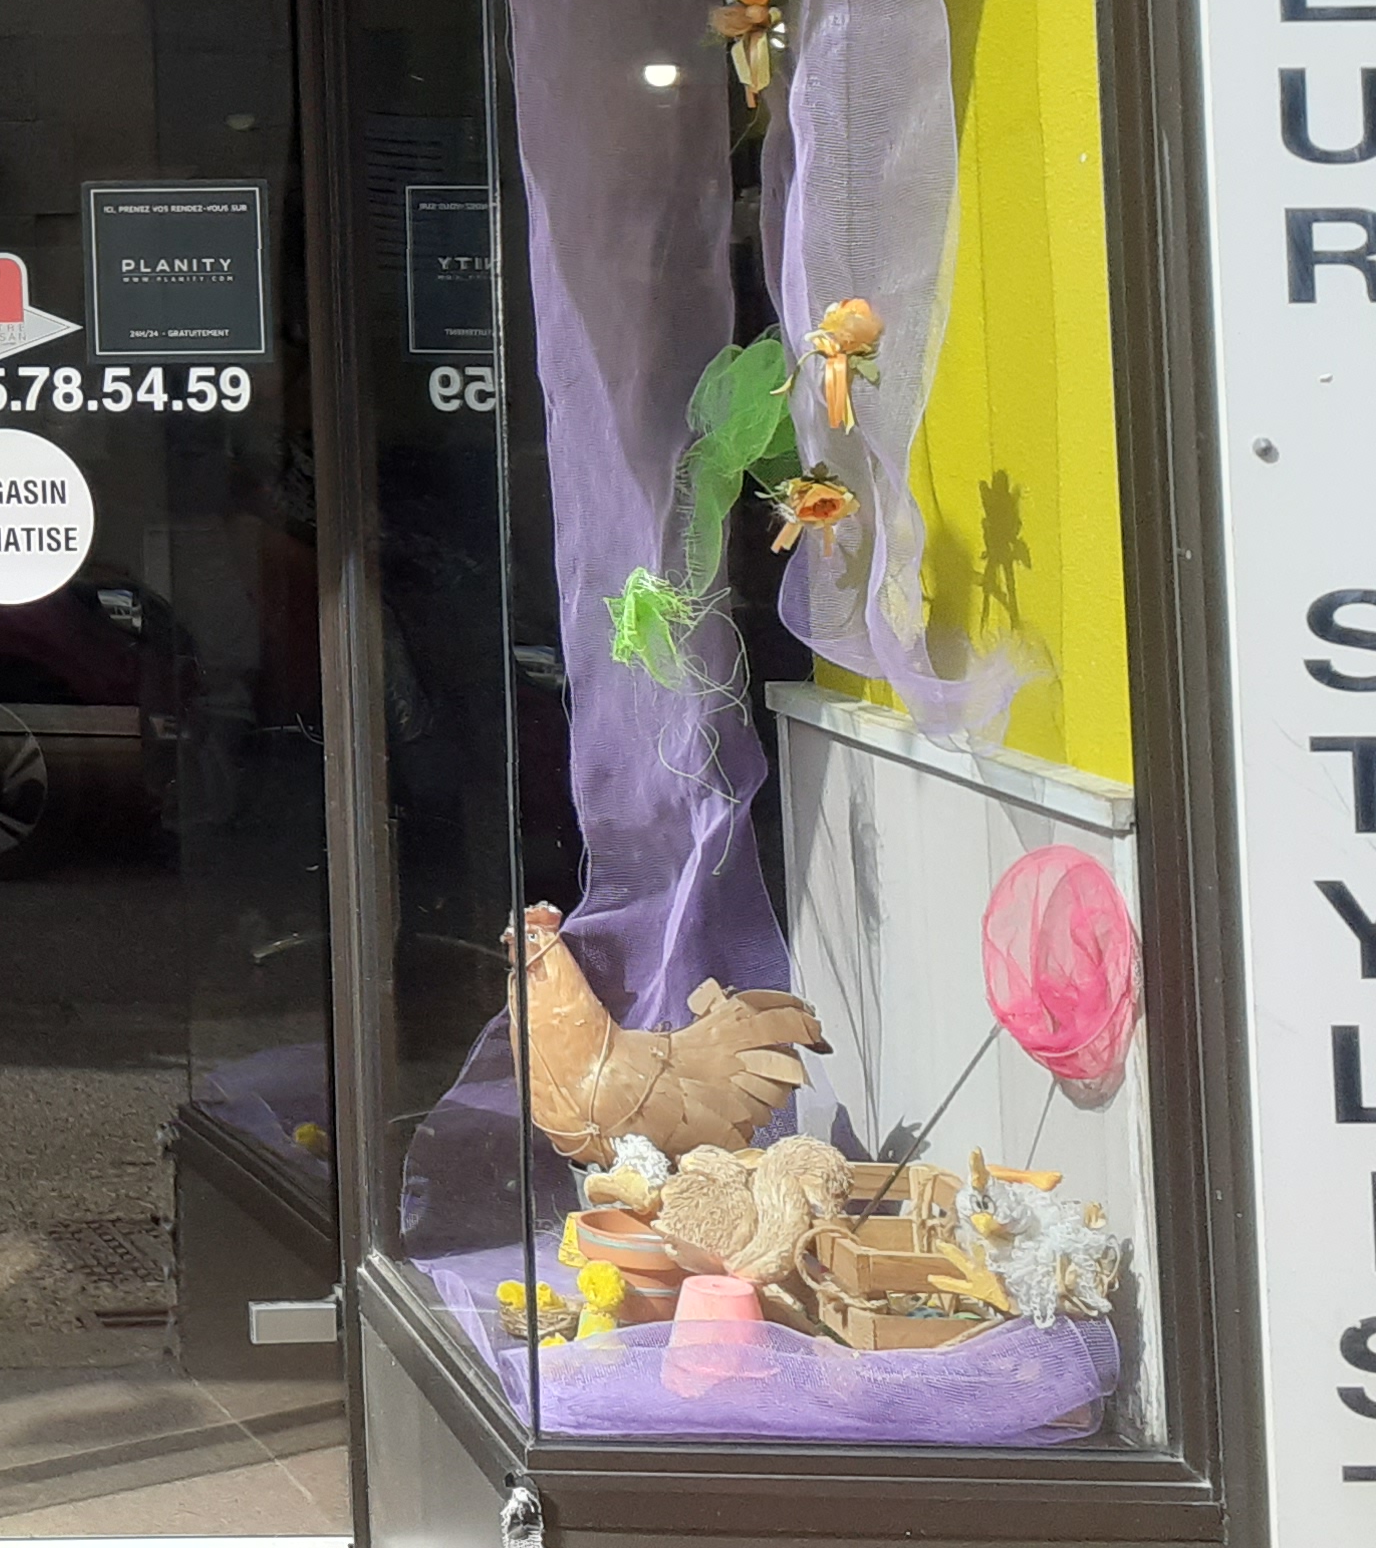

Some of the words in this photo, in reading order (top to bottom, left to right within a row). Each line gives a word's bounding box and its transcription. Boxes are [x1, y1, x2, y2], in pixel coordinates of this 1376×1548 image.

[118, 205, 150, 213] PRENEZ
[171, 204, 228, 212] RENDEZ-VOUS
[231, 204, 247, 212] SUR
[122, 258, 232, 273] PLANITY
[168, 328, 229, 337] GRATUITEMENT
[1304, 588, 1376, 1484] STYL
